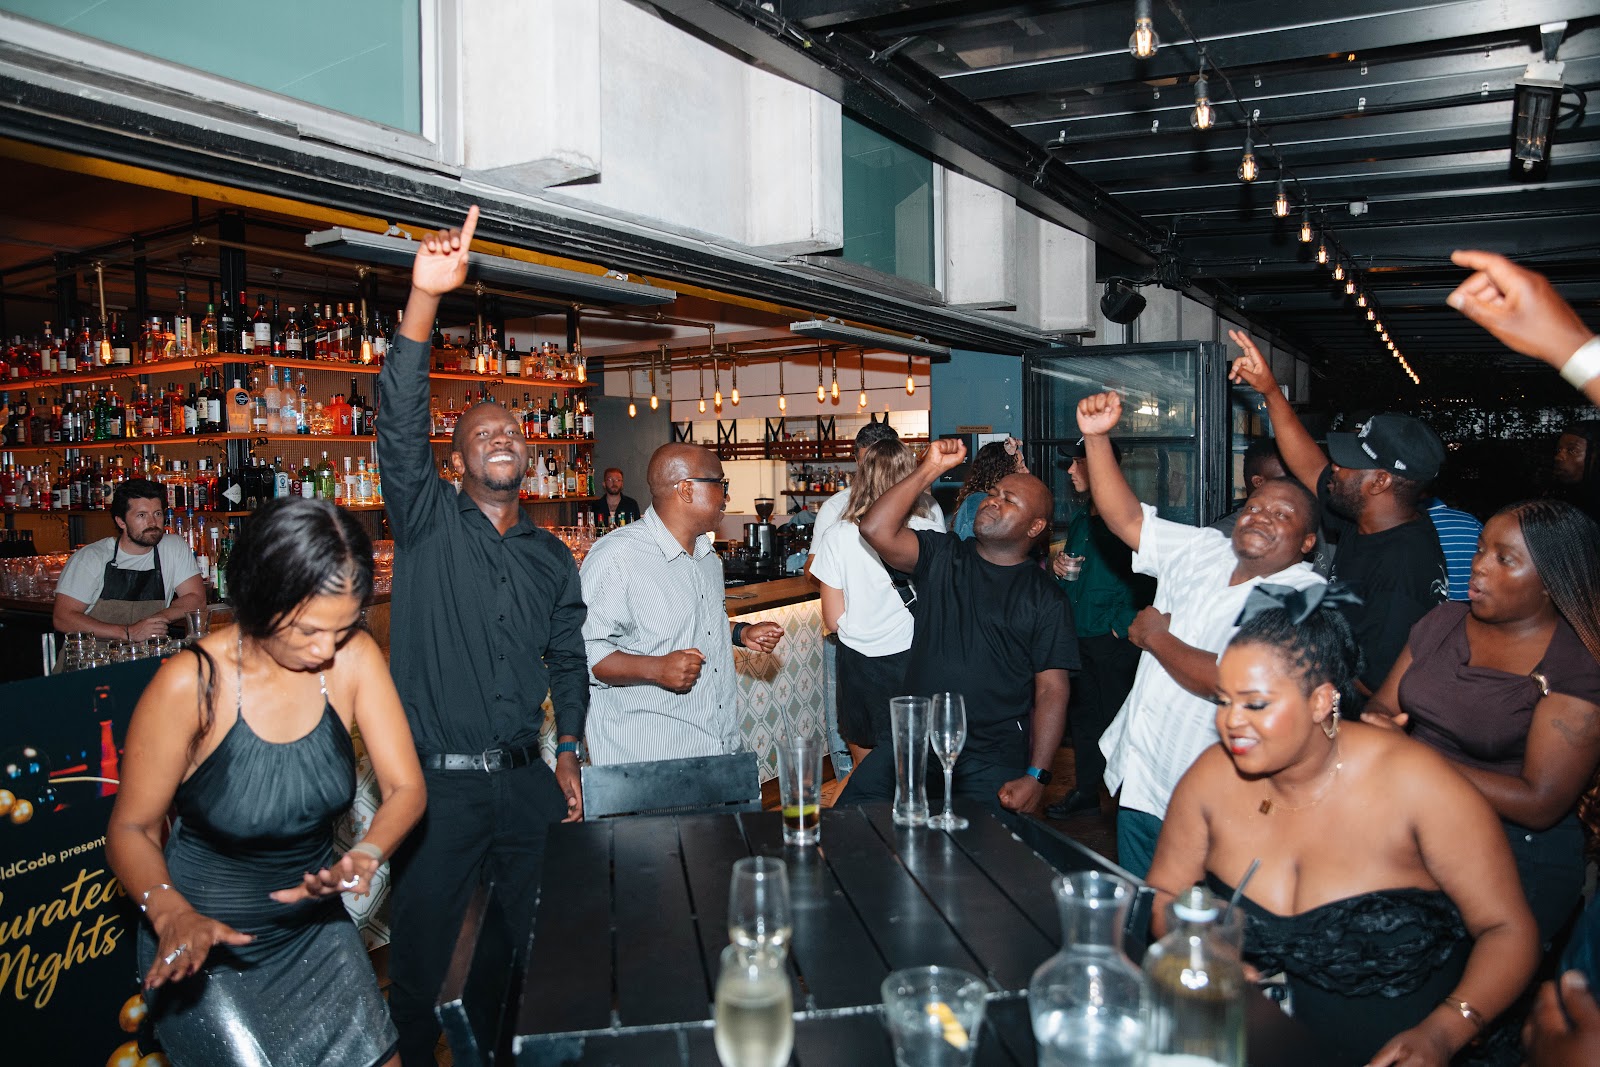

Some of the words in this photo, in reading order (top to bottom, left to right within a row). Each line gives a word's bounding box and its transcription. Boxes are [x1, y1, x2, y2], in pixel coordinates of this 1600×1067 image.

[0, 852, 56, 880] ldCode
[60, 836, 106, 862] present
[0, 868, 127, 946] urated
[0, 914, 124, 1009] Nights
